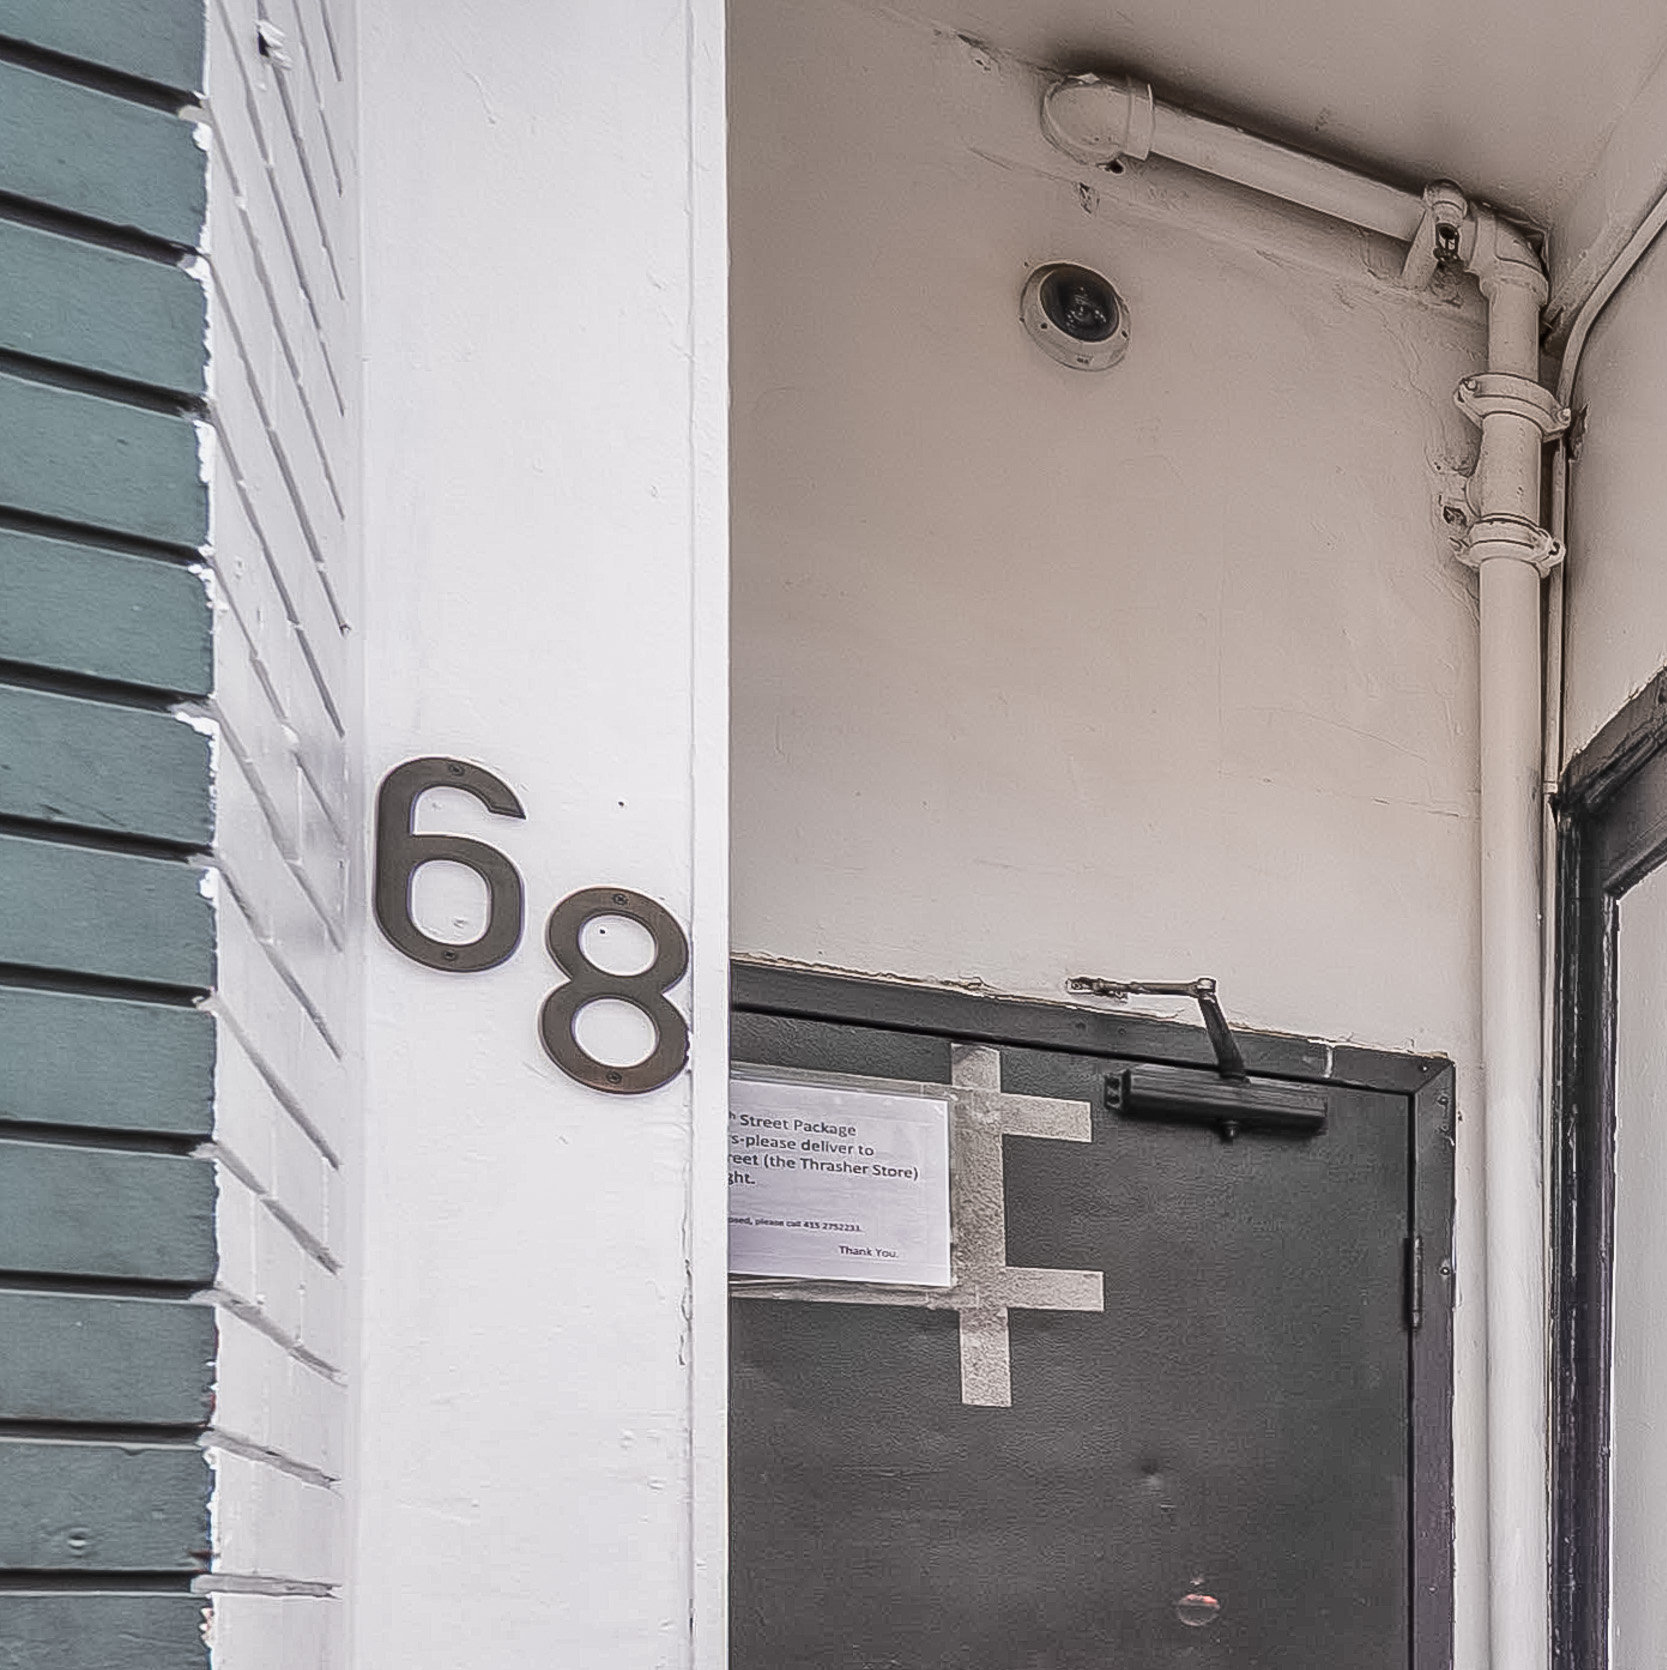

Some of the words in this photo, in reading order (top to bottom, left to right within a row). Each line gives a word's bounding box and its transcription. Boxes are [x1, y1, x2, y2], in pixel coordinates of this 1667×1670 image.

[739, 1113, 789, 1131] Street
[793, 1118, 857, 1138] Package
[800, 1138, 853, 1155] deliver
[858, 1144, 875, 1157] to
[763, 1153, 796, 1170] (the
[800, 1157, 868, 1175] Thrasher
[872, 1163, 919, 1181] Store)
[838, 1244, 873, 1258] Thank
